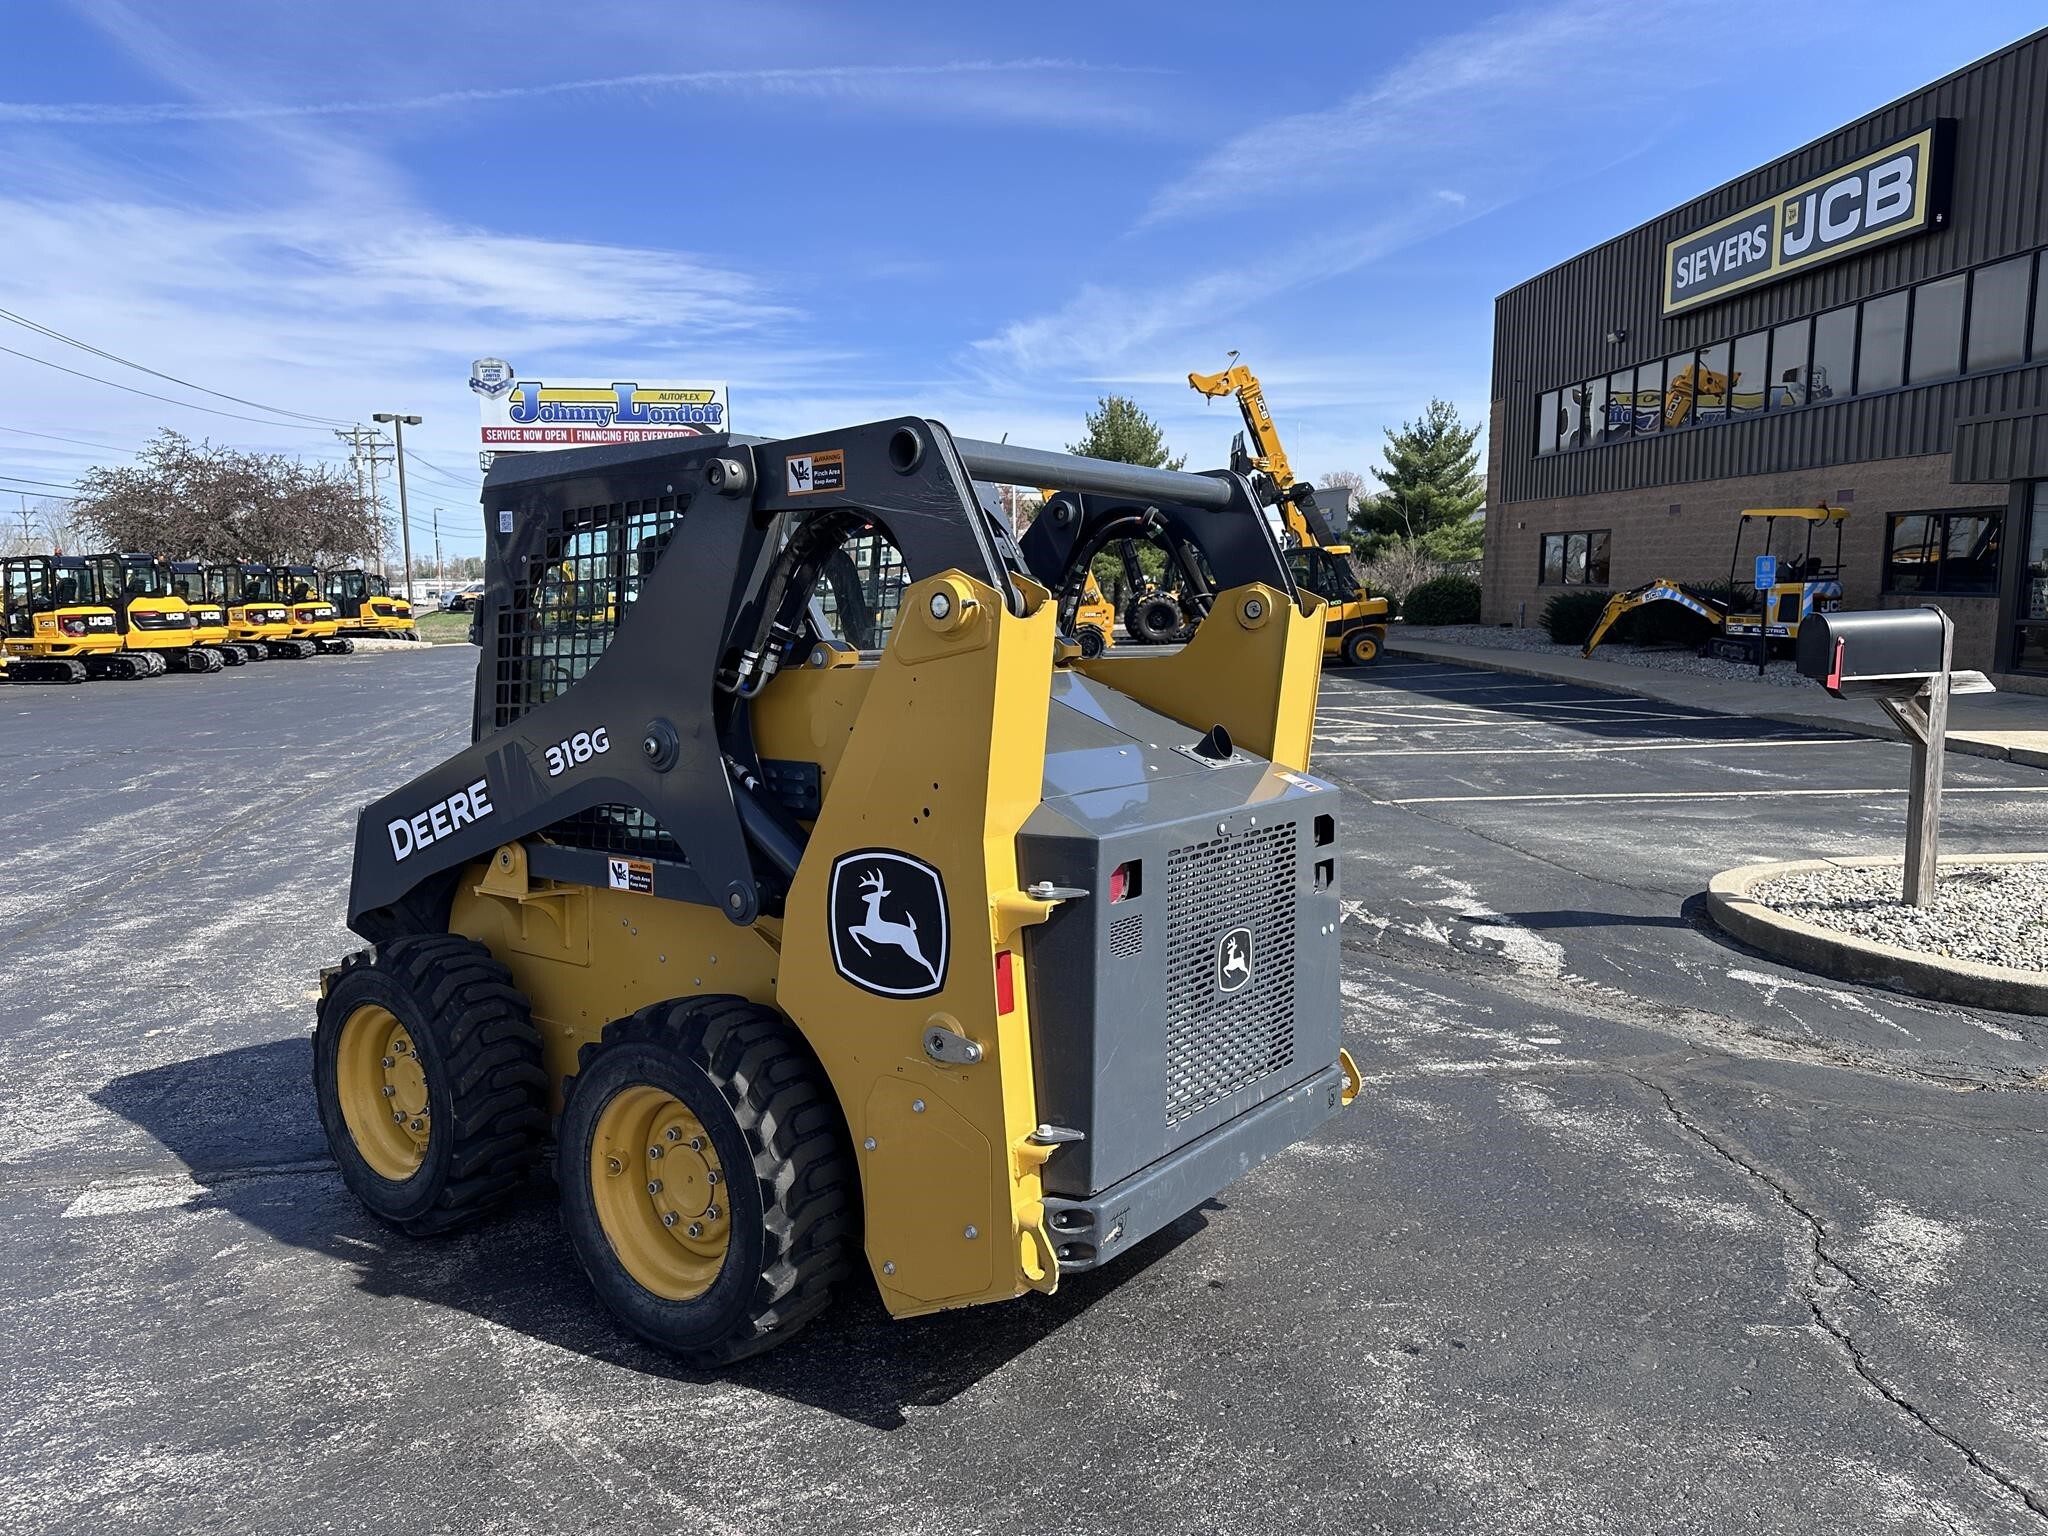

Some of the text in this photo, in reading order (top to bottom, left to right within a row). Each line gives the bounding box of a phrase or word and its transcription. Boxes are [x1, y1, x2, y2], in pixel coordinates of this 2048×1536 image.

[1676, 155, 1913, 289] SIEVERS JCB
[658, 392, 700, 401] AUTOPLEX
[510, 383, 722, 425] Johnny Londoff
[1256, 396, 1269, 420] JCB
[486, 429, 521, 441] SERVICE
[523, 430, 542, 441] NOW
[545, 430, 567, 441] OPEN
[576, 430, 622, 442] FINANCING
[624, 431, 640, 442] FOR
[166, 612, 185, 620] JCB
[200, 611, 220, 620] JCB
[267, 610, 285, 618] JCB
[88, 616, 113, 626] JCB
[545, 727, 610, 776] 318G
[388, 778, 494, 862] DEERE
